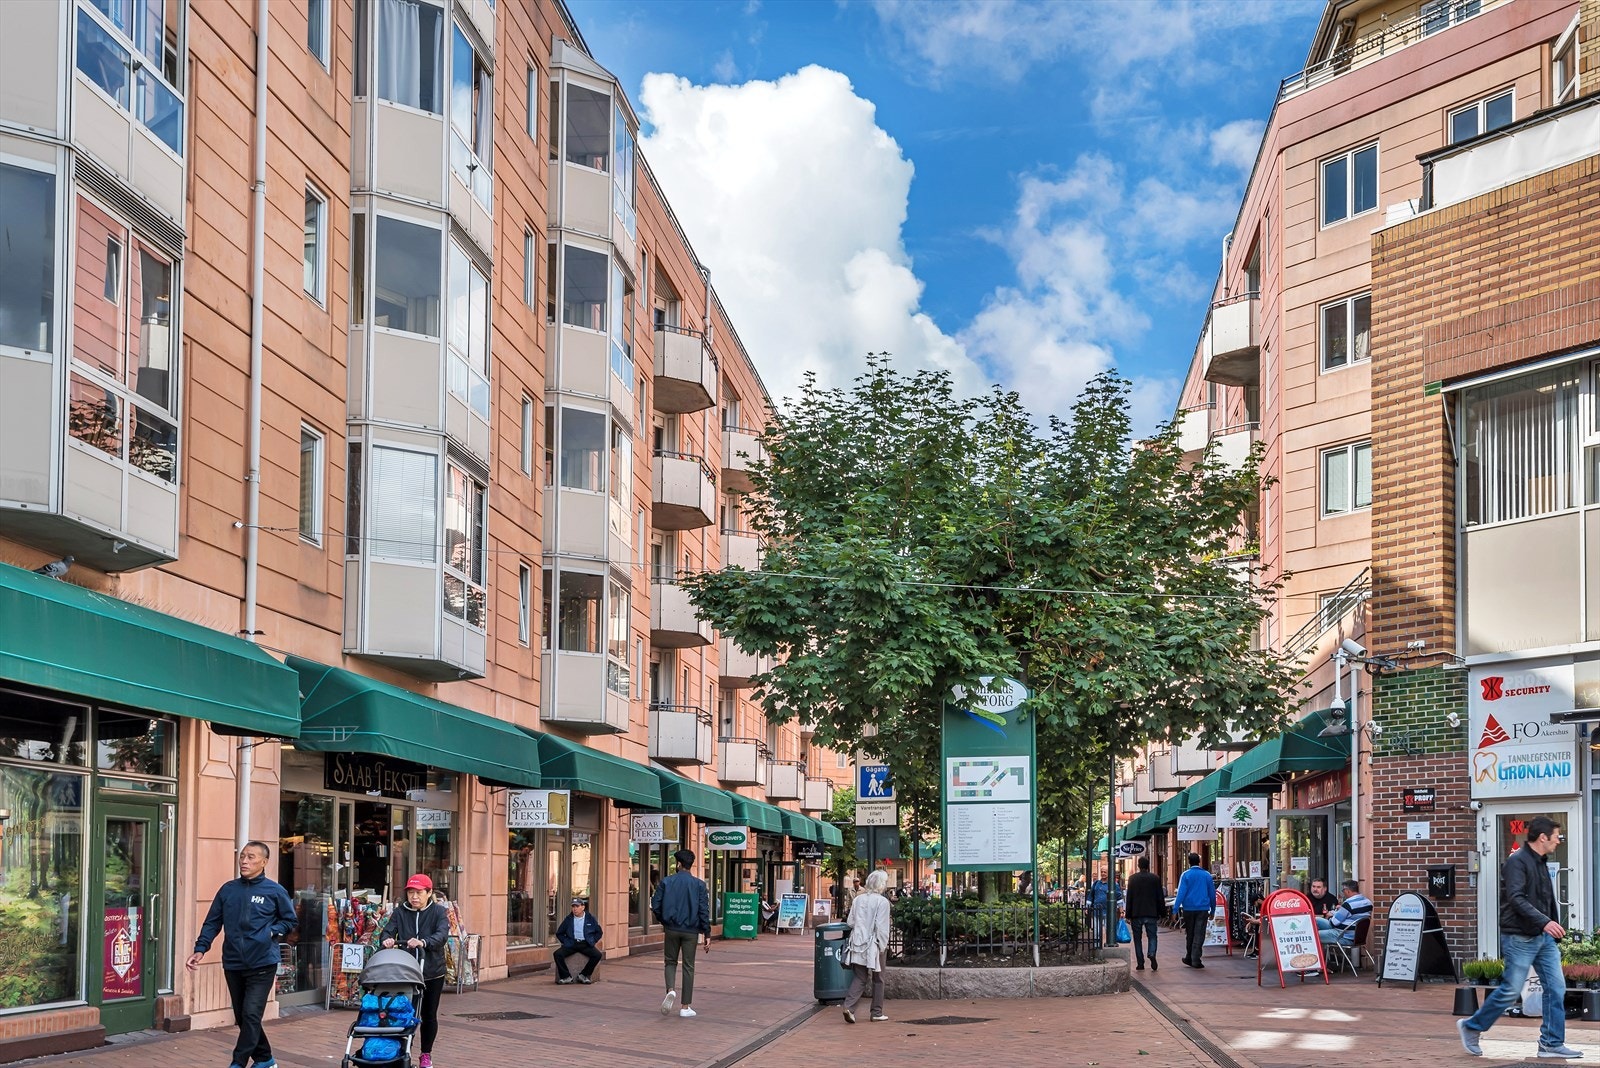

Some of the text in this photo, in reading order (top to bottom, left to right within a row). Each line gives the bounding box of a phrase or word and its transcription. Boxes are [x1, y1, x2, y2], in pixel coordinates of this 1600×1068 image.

[1505, 685, 1551, 697] SECURITY
[1512, 721, 1540, 739] FO
[1540, 729, 1569, 737] Akershus
[1508, 751, 1571, 763] TANNLEGESENTER
[333, 753, 372, 788] SAAB
[1498, 761, 1571, 780] GRØNLAND
[512, 797, 543, 808] SAAB
[1227, 800, 1258, 813] BEIRUT KEBAB
[635, 820, 659, 828] SAAB
[712, 834, 743, 842] Specsavers
[1433, 876, 1446, 885] POST
[250, 895, 265, 905] HH
[1295, 935, 1313, 943] pizza
[1285, 943, 1308, 955] 120,-
